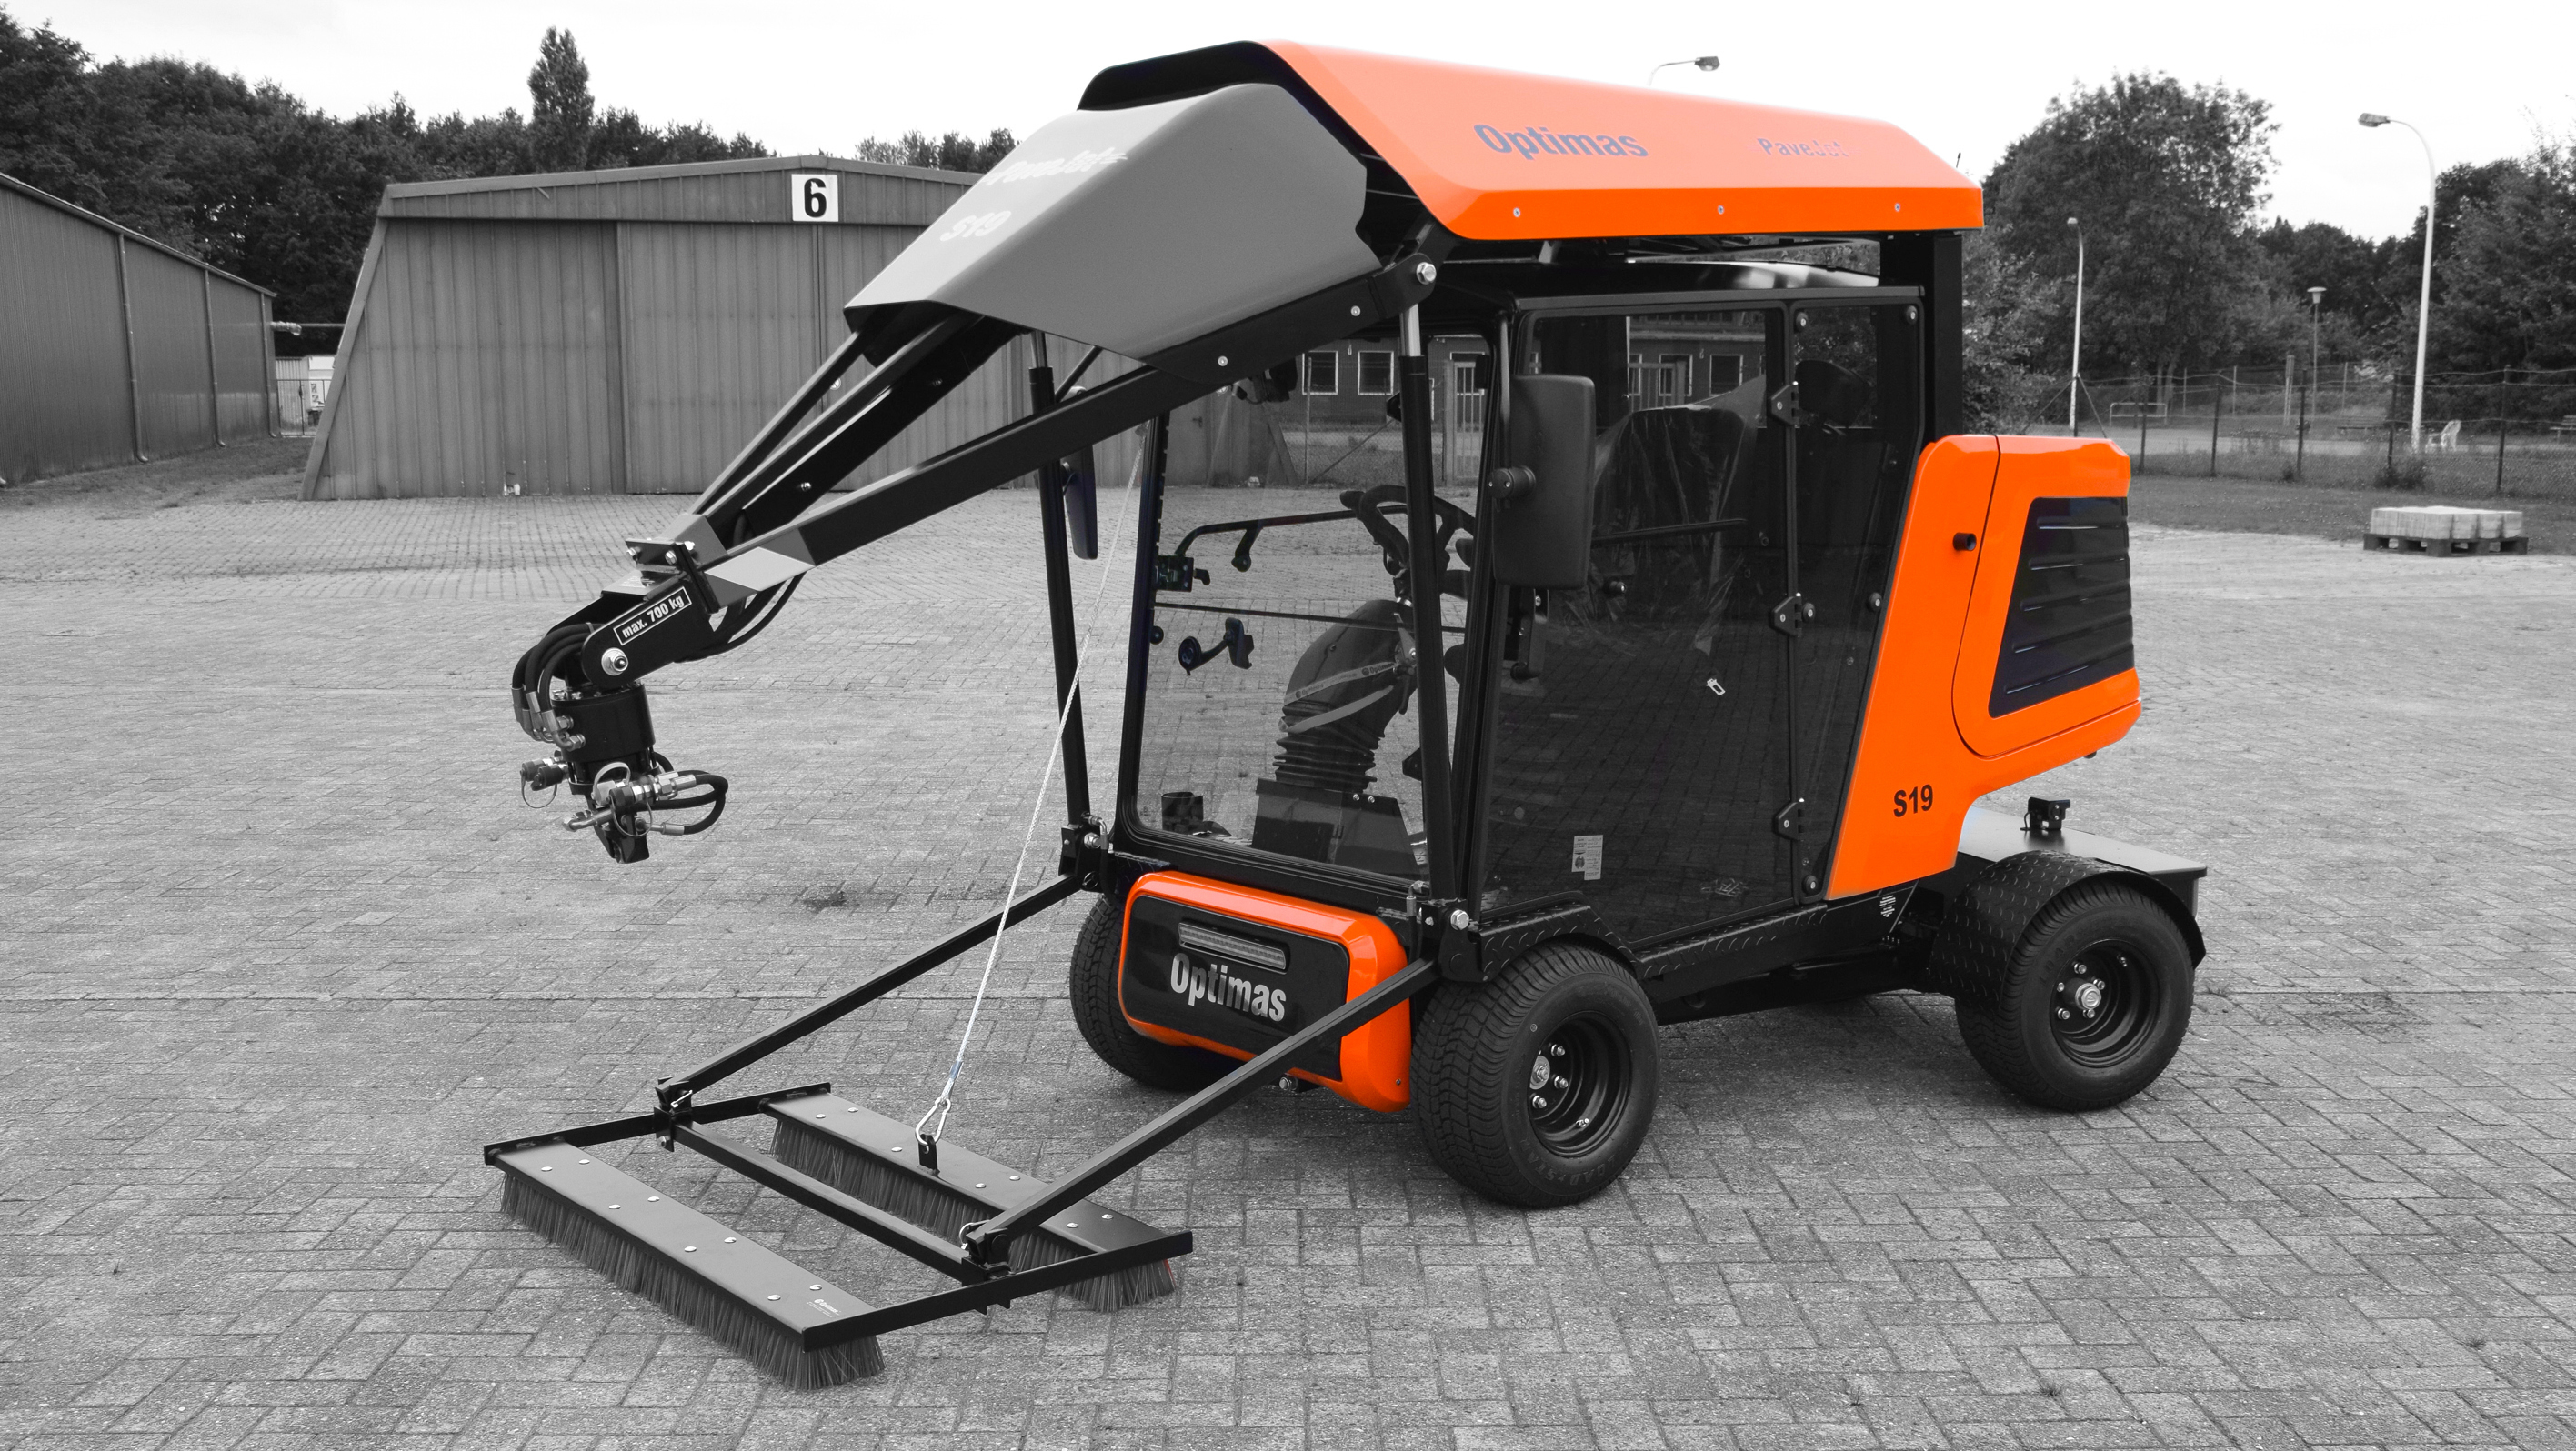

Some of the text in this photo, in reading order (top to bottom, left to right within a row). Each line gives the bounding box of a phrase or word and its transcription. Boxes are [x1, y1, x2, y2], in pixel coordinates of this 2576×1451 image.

[1473, 124, 1649, 161] Optimas
[804, 177, 827, 218] 6
[939, 210, 1011, 242] S19
[621, 595, 685, 638] max. 700 kg
[1893, 784, 1934, 817] S19
[1170, 952, 1288, 1022] Optimas
